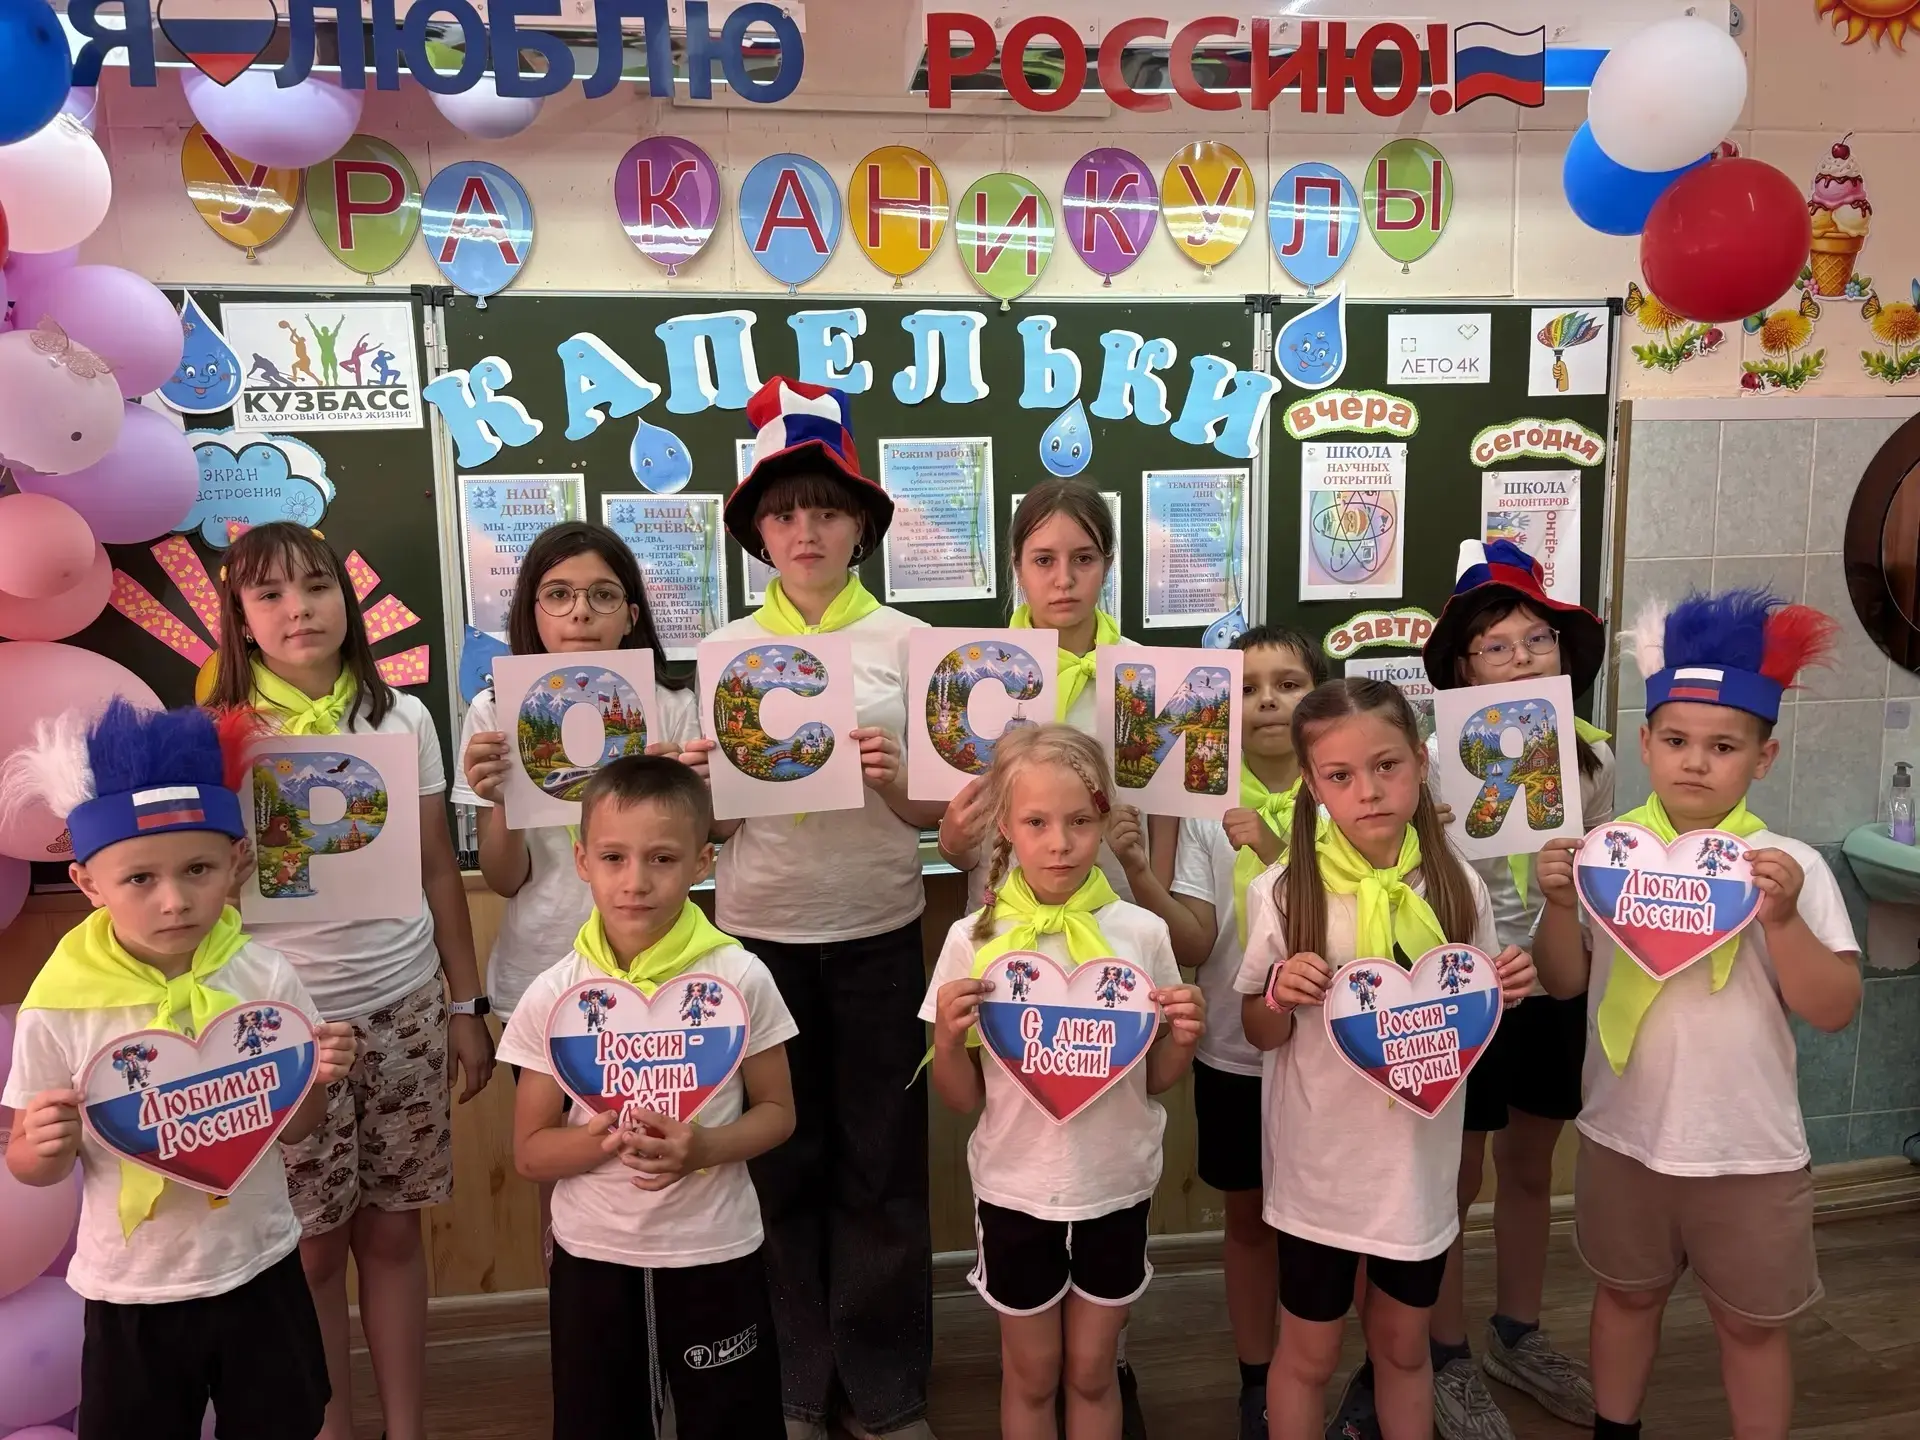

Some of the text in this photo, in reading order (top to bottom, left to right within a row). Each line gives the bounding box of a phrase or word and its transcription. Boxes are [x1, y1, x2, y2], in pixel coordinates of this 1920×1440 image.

[68, 0, 804, 103] Я ЛЮБЛЮ
[926, 12, 1454, 116] РОССИЮ!
[202, 133, 1442, 276] УРА КАНИКУЛЫ
[1401, 357, 1479, 373] ЛЕТО 4К
[423, 307, 1280, 467] КАПЕЛЬКИ
[244, 390, 409, 413] КУЗБАСС
[245, 411, 411, 422] ЗА ЗДОРОВЫЙ ОБРАЗ ЖИЗНИ!
[1290, 396, 1411, 433] вчера
[1475, 426, 1599, 462] сегодня
[892, 449, 934, 459] Режим
[1326, 446, 1392, 459] ШКОЛА
[1327, 462, 1390, 473] НАУЧНЫХ
[1168, 481, 1239, 489] ТЕМАТИЧЕСКИЕ
[1323, 473, 1392, 485] ОТКРЫТИЙ
[196, 487, 281, 502] астроения
[1193, 490, 1213, 498] ДНИ
[1504, 482, 1566, 494] ШКОЛА
[1499, 497, 1570, 507] ВОЛОНТЕРОВ
[500, 504, 555, 517] ДЕВИЗ
[644, 507, 693, 519] НАША
[483, 523, 505, 531] МЫ
[634, 520, 705, 534] РЕЧЁВКА
[648, 576, 685, 584] ДРУЖНО
[1331, 618, 1432, 652] завтр
[1023, 1010, 1040, 1039] С
[690, 1348, 704, 1356] JUST
